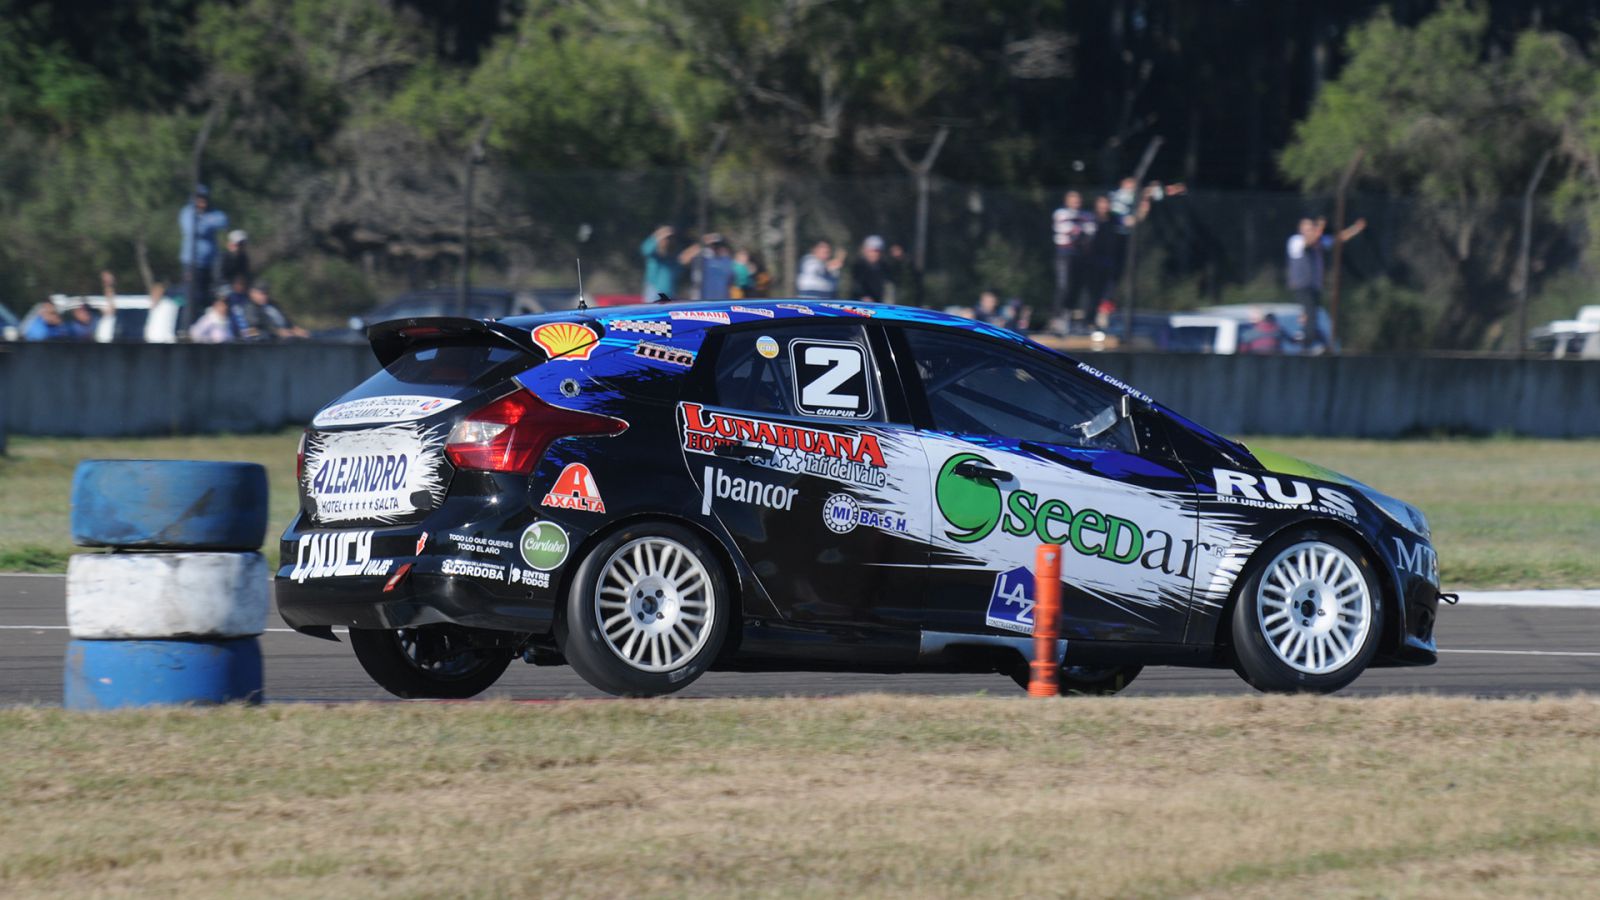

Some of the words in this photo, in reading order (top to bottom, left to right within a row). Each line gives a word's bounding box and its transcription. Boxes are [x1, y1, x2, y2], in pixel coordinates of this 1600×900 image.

[683, 306, 728, 319] YAMAHA
[802, 346, 861, 408] 2
[1077, 362, 1103, 377] FACU
[1103, 375, 1141, 398] CHAPUR
[816, 408, 855, 417] CHAPUR
[683, 403, 887, 467] LUNAHUANA
[830, 461, 852, 480] del
[854, 464, 886, 486] Valle
[716, 469, 799, 511] bancor
[1212, 468, 1357, 517] RUS
[321, 501, 342, 513] HOTEL
[374, 497, 399, 510] SALTA
[542, 494, 605, 512] AXALTA
[1240, 498, 1298, 510] URUGUAY
[1301, 504, 1359, 524] SEGUROS
[832, 506, 851, 520] MI
[449, 534, 465, 542] TODO
[465, 535, 474, 543] LO
[474, 537, 487, 545] QUE
[457, 543, 476, 551] TODO
[485, 545, 500, 555] AÑO
[522, 577, 550, 588] TODOS
[523, 569, 550, 581] ENTRE
[998, 574, 1035, 624] LAZ
